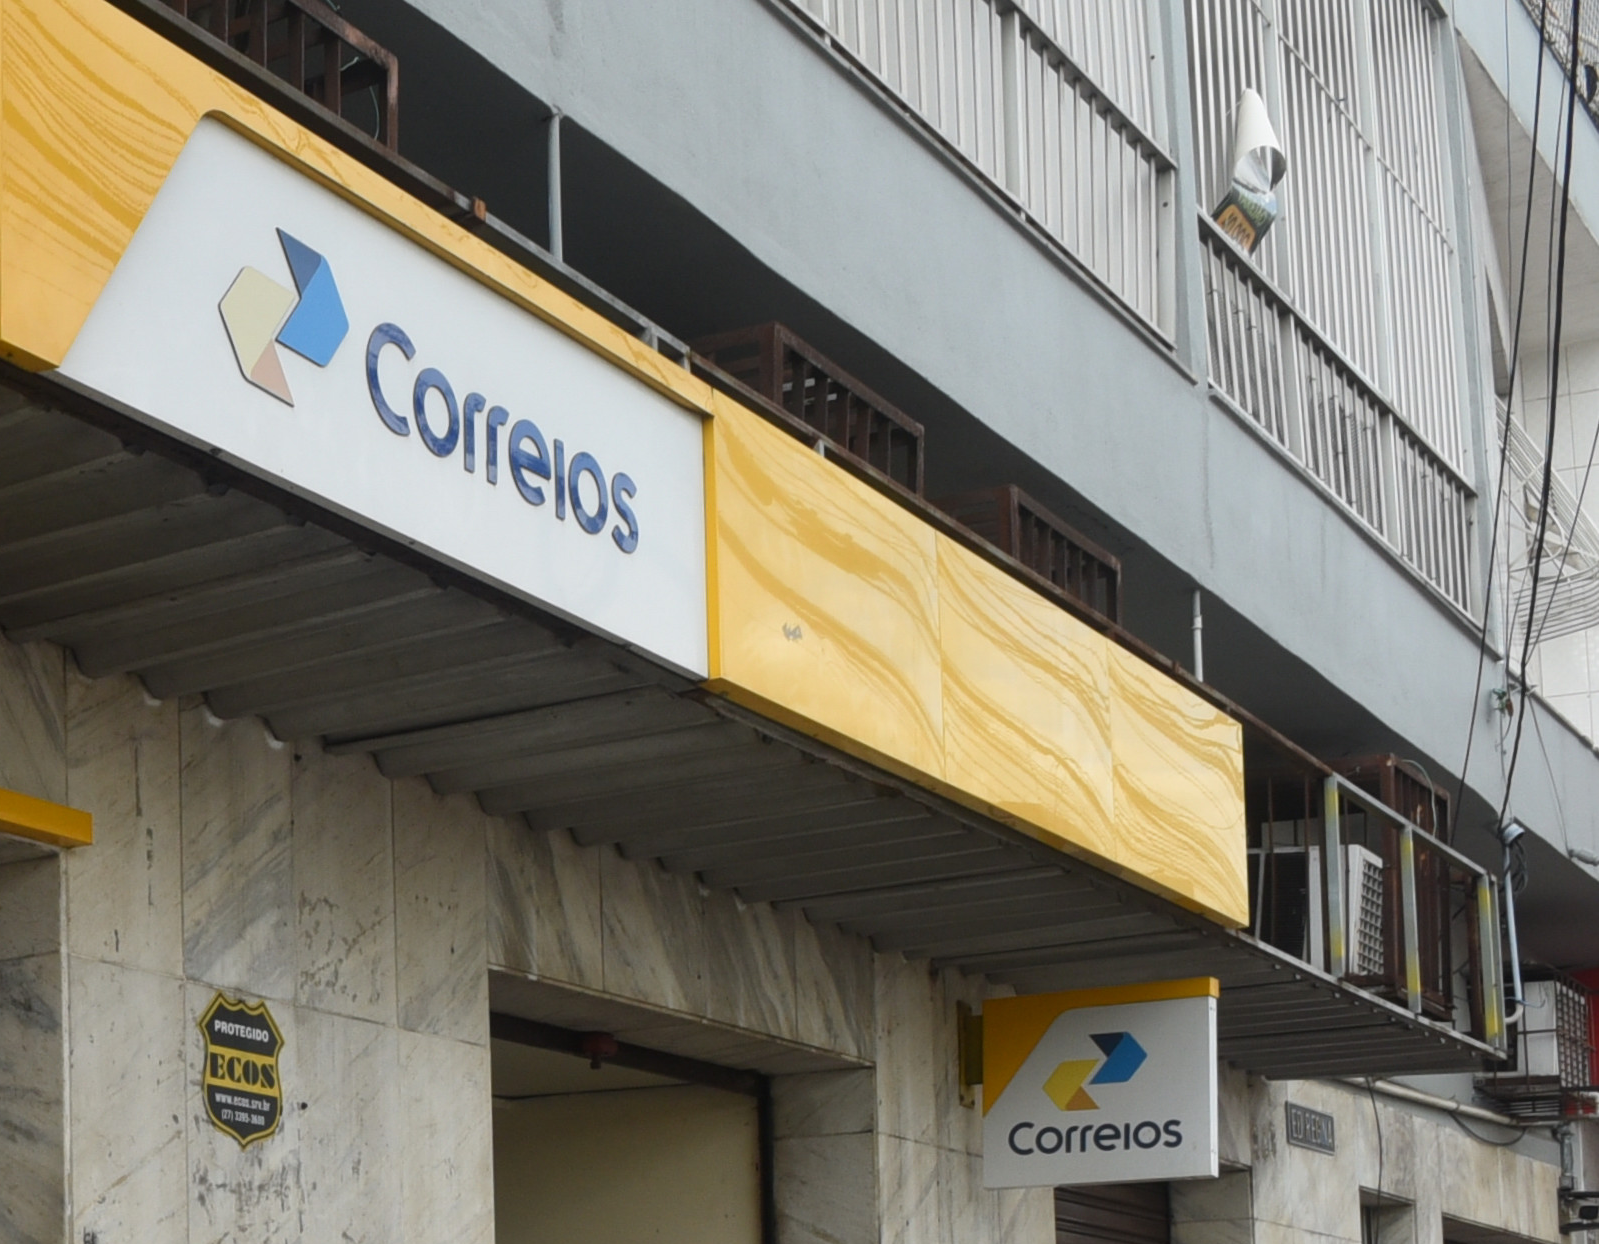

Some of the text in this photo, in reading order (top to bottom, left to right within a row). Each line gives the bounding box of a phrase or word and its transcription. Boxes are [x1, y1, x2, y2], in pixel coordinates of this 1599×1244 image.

[366, 322, 639, 554] Correios
[214, 1019, 270, 1043] PROTEGIDO
[209, 1051, 276, 1090] ECOS
[1007, 1119, 1183, 1156] Correios
